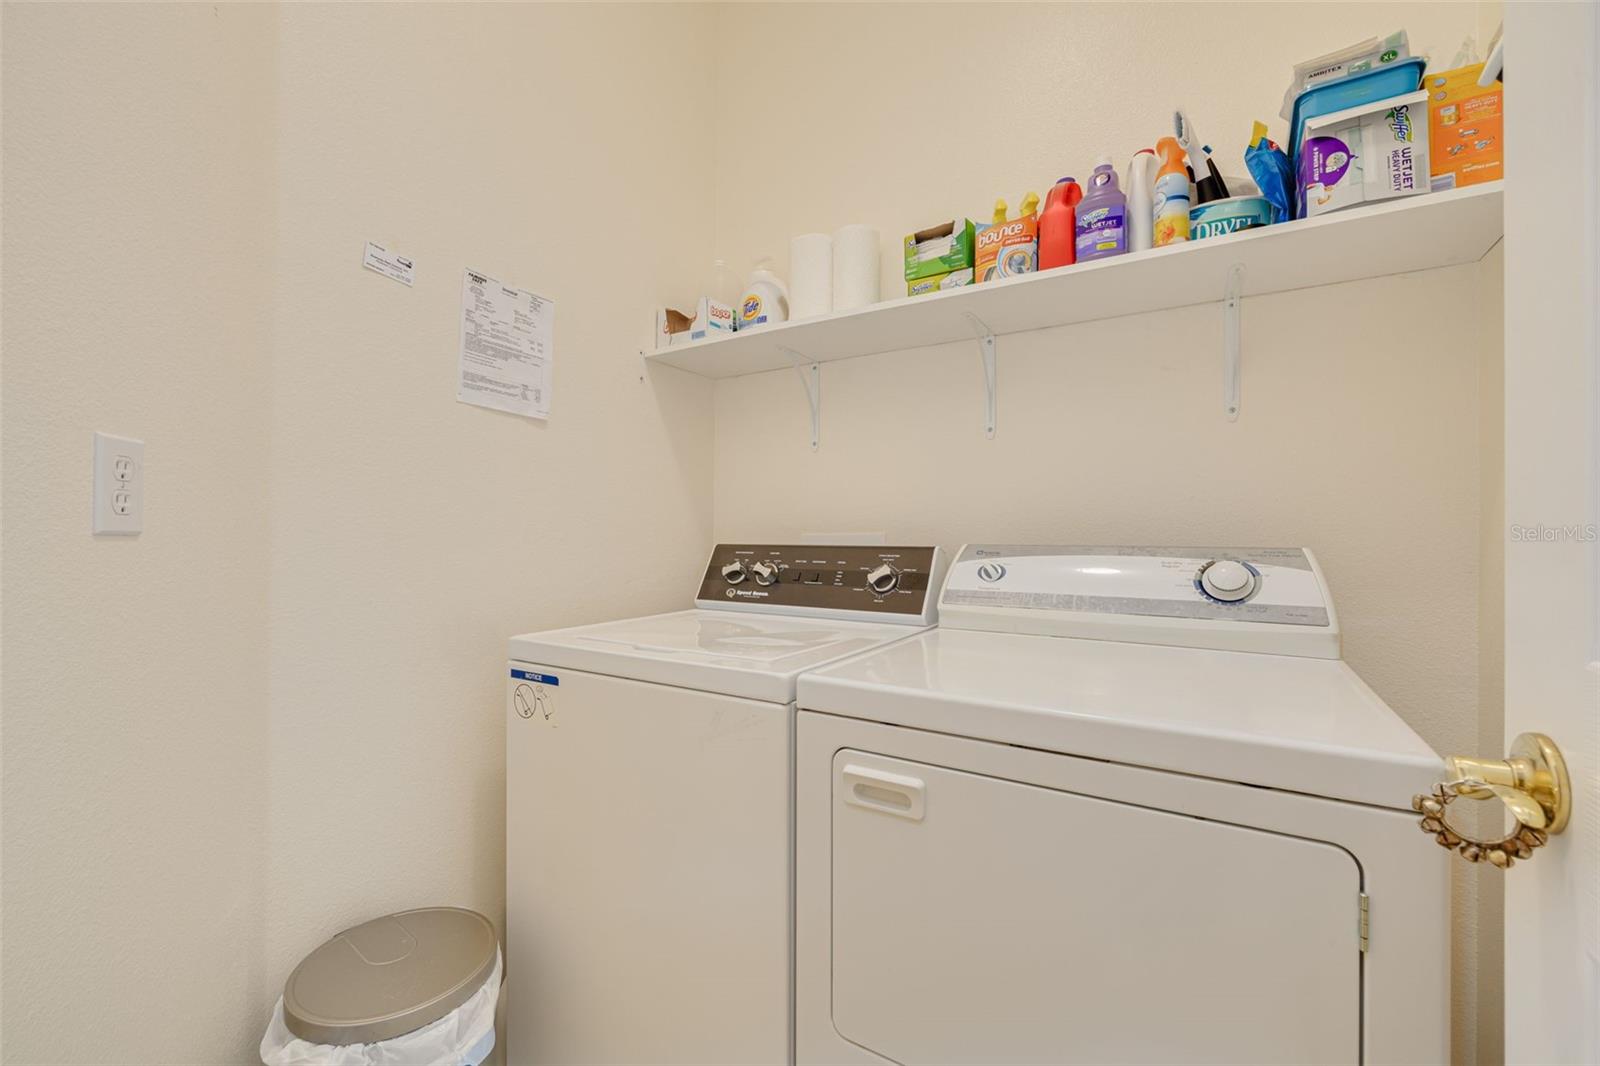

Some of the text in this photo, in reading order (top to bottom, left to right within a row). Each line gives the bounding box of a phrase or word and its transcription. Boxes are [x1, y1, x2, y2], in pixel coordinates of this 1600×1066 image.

[1382, 52, 1397, 62] XL
[1308, 65, 1342, 79] AMBITEX
[1391, 104, 1409, 142] Swiffer
[1391, 149, 1402, 191] HEAVY DUTY
[1401, 146, 1413, 189] WETJET
[978, 223, 1024, 249] bounce
[743, 301, 760, 316] Tide
